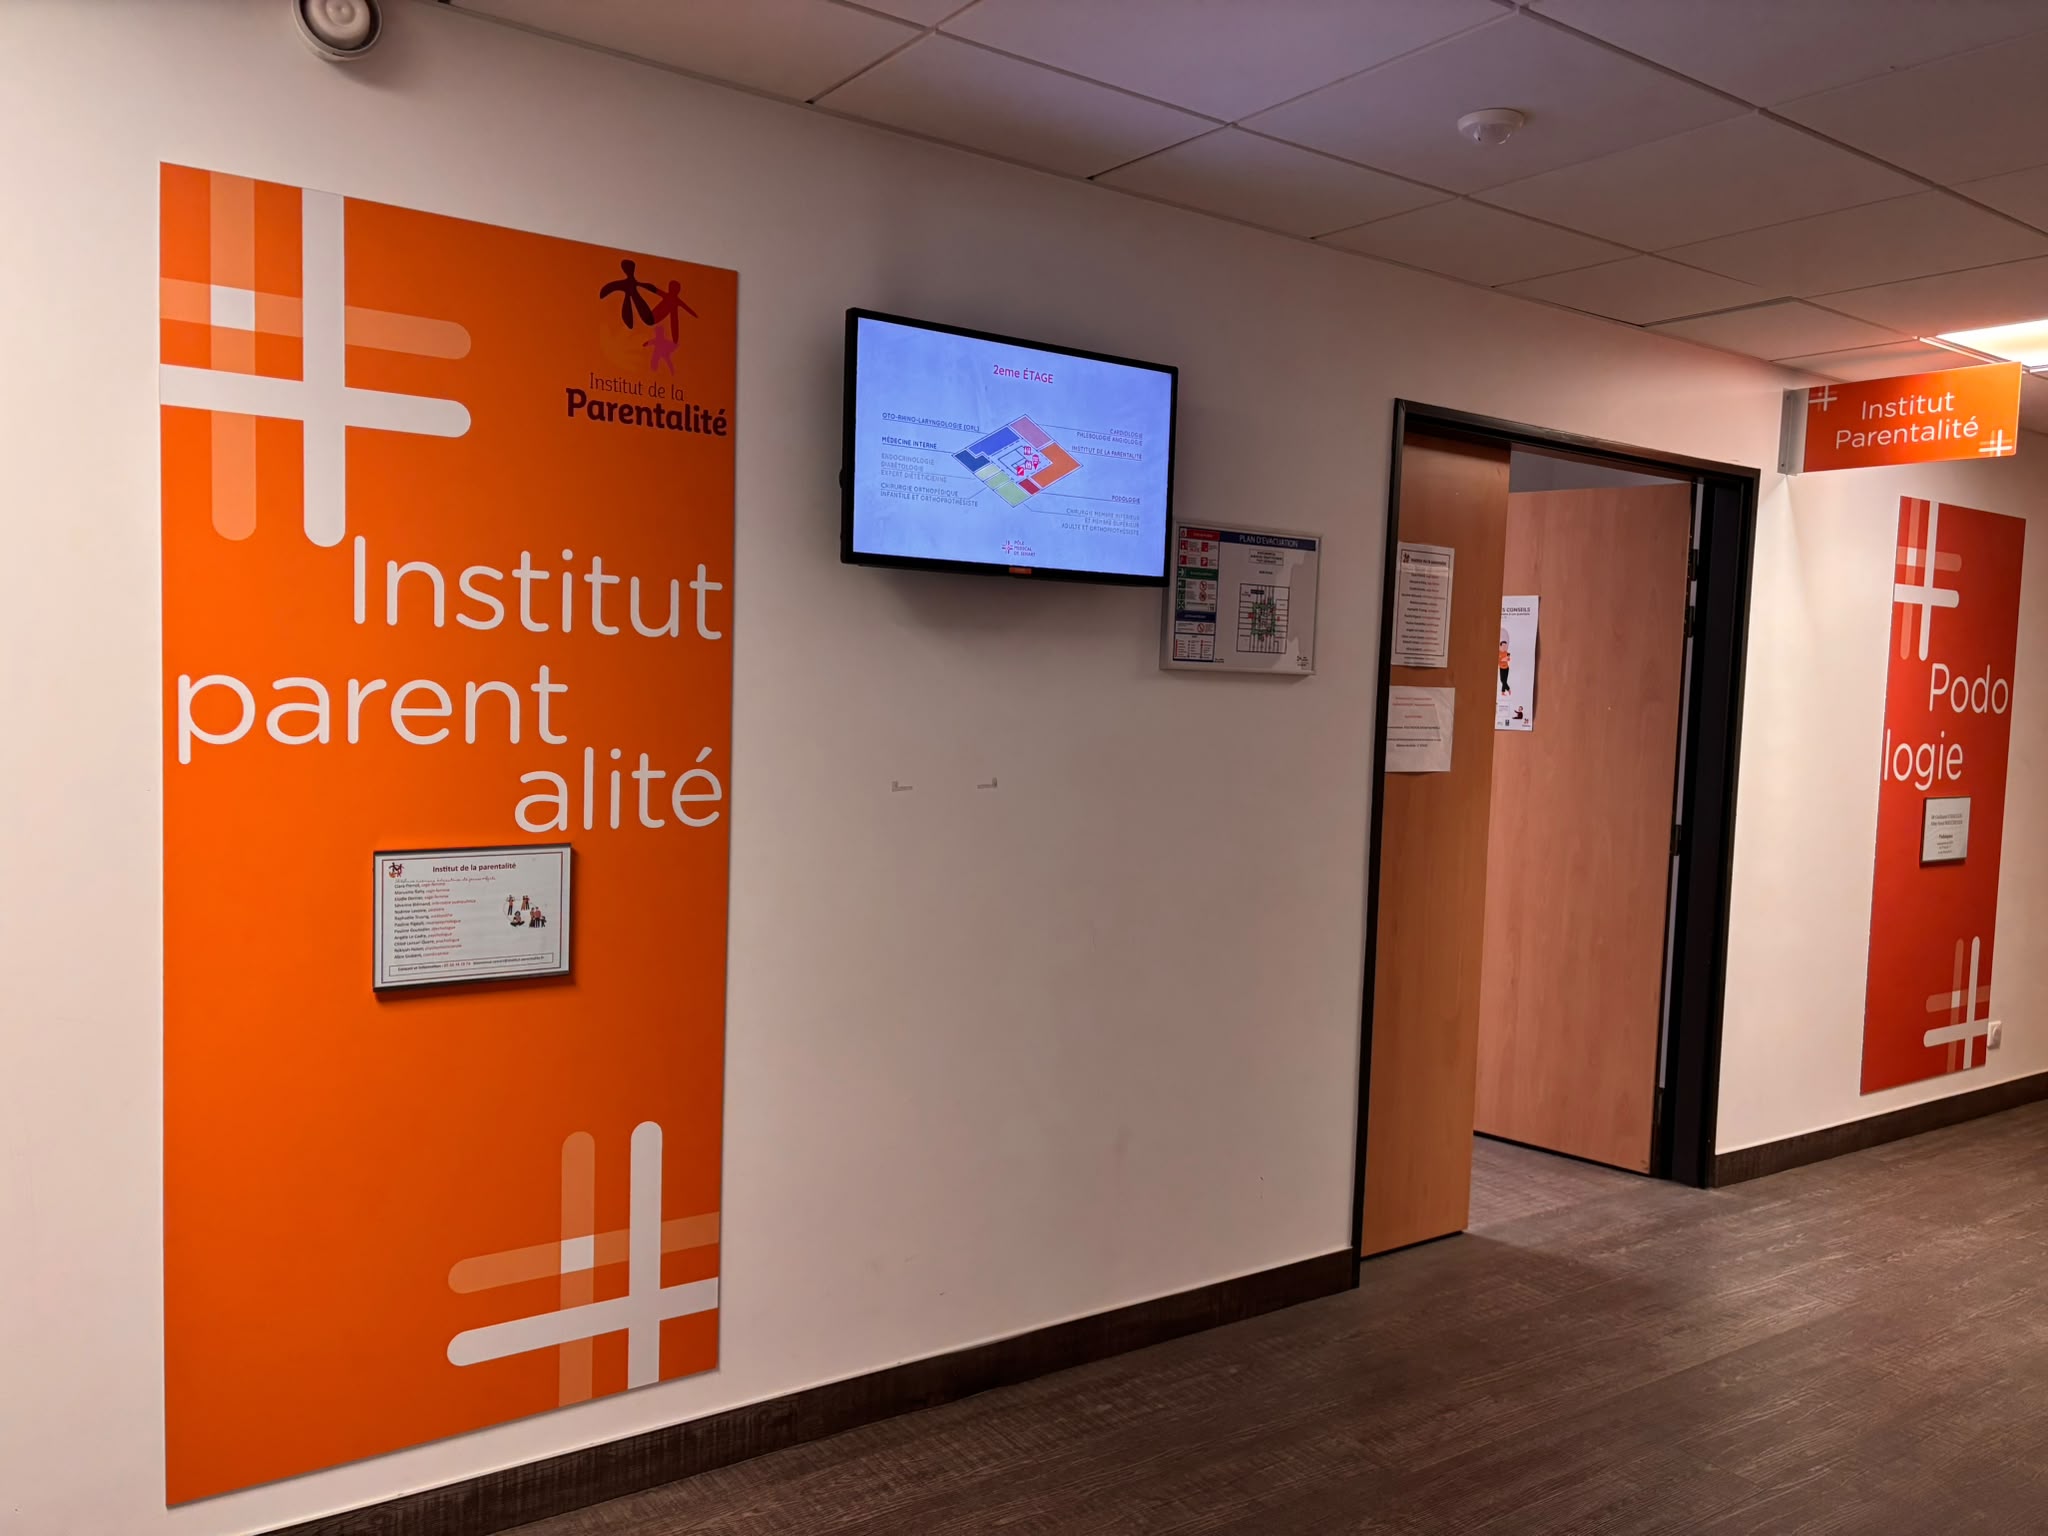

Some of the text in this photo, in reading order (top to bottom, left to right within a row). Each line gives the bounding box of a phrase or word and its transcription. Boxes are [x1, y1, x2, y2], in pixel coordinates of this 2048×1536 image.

[993, 364, 1053, 384] 2eme ÉTAGE
[590, 372, 684, 401] Institut de la
[565, 387, 727, 436] Parentalité
[1861, 391, 1955, 420] Institut
[881, 436, 937, 449] MÉDECINE INTERNE
[1110, 428, 1143, 439] CARDIOLOGIE
[1836, 416, 1979, 449] Parentalité
[1071, 445, 1095, 453] INSTITUT
[881, 453, 935, 466] ENDOCRINOLOGIE
[880, 482, 912, 492] CHIRURGIE
[880, 490, 910, 500] INFANTILE
[1112, 495, 1140, 504] PODOLOGIE
[1239, 534, 1256, 544] PLAN
[354, 535, 722, 640] Institut
[1929, 662, 2009, 714] Podo
[178, 665, 568, 765] parent
[1884, 728, 1963, 791] logie
[514, 746, 722, 833] alité
[432, 865, 459, 873] Institut
[460, 864, 469, 872] de
[478, 862, 517, 872] parentalité
